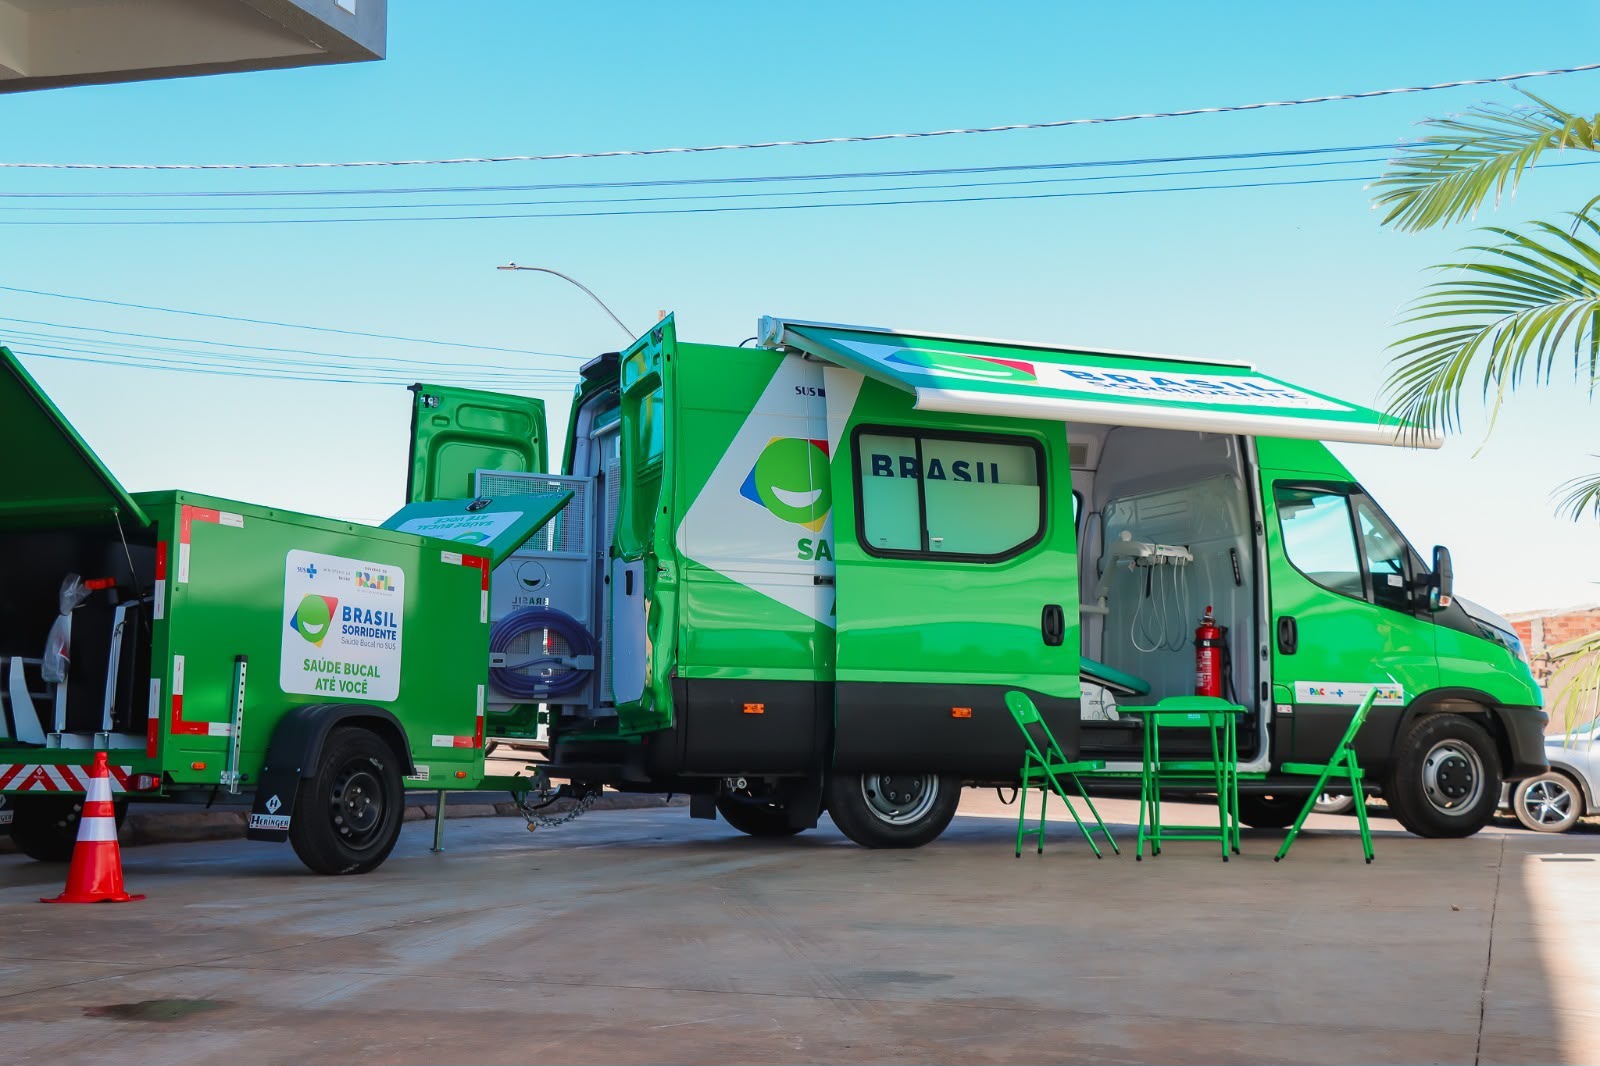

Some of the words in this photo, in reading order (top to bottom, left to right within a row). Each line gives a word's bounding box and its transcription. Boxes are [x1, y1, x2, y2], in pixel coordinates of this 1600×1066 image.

[1059, 369, 1285, 392] BRASIL
[795, 386, 816, 396] SUS
[342, 605, 397, 628] BRASIL
[342, 624, 397, 641] SORRIDENTE
[341, 636, 360, 646] Saúde
[360, 638, 376, 648] Bucal
[376, 641, 384, 649] no
[384, 642, 397, 650] SUS
[303, 657, 341, 675] SAÚDE
[343, 662, 381, 678] BUCAL
[315, 676, 336, 692] ATÉ
[339, 679, 368, 694] VOCÊ
[1309, 687, 1325, 696] PAC
